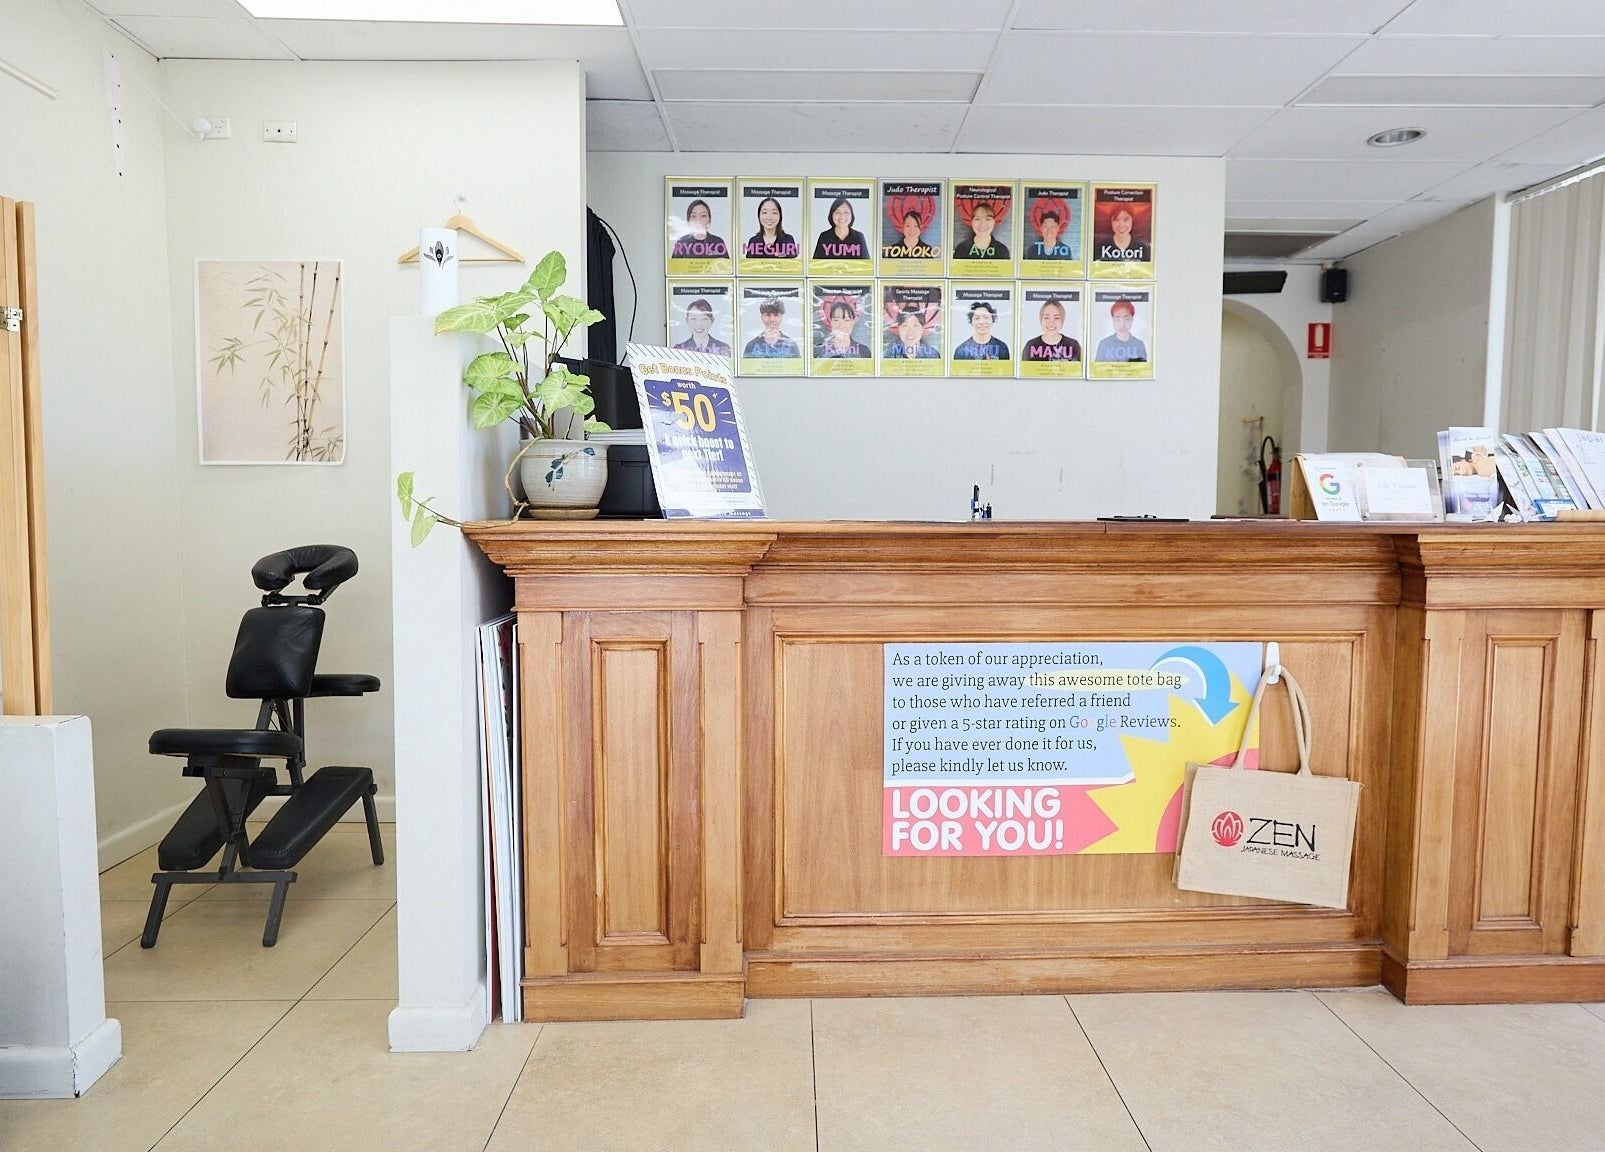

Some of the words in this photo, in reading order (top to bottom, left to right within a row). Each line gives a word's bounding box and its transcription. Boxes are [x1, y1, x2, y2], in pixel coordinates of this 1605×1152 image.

[674, 242, 726, 256] RYOKO
[743, 242, 801, 256] MEGURI
[822, 243, 861, 257] YUMI
[882, 245, 940, 258] TOMOKO
[969, 244, 996, 258] Aya
[1101, 245, 1143, 259] Kotori
[1030, 346, 1073, 358] MAYU
[639, 363, 658, 375] Get
[660, 363, 693, 376] Bonus
[694, 366, 728, 385] Points
[676, 381, 696, 389] worth
[661, 391, 717, 433] $50
[698, 436, 724, 449] boost
[724, 438, 735, 450] to
[892, 652, 910, 666] As
[913, 655, 922, 666] a
[926, 651, 964, 666] token
[968, 650, 983, 665] of
[985, 654, 1008, 665] our
[1012, 651, 1103, 668] appreciation,
[892, 677, 913, 687] we
[917, 676, 939, 687] are
[942, 674, 984, 691] giving
[988, 675, 1026, 690] away
[1029, 672, 1055, 686] this
[1058, 675, 1123, 686] awesome
[1127, 673, 1153, 686] tote
[1157, 672, 1182, 690] bag
[892, 696, 906, 709] to
[910, 694, 947, 709] those
[950, 694, 981, 708] who
[984, 693, 1018, 708] have
[1021, 693, 1075, 708] referred
[1079, 697, 1087, 707] a
[1090, 693, 1131, 707] friend
[892, 719, 906, 730] or
[909, 716, 947, 733] given
[951, 719, 959, 730] a
[962, 717, 1002, 731] 5-star
[1005, 716, 1046, 733] rating
[1049, 718, 1066, 729] on
[1069, 714, 1117, 732] Gogle
[1120, 715, 1181, 728] Reviews.
[892, 737, 904, 751] If
[905, 740, 931, 755] you
[935, 736, 968, 751] have
[972, 740, 1002, 751] ever
[1005, 736, 1039, 751] done
[1042, 737, 1052, 750] it
[1055, 736, 1074, 750] for
[1077, 739, 1097, 752] us,
[892, 758, 936, 776] please
[940, 757, 984, 776] kindly
[987, 757, 1005, 772] let
[1008, 760, 1024, 772] us
[1027, 757, 1067, 772] know.
[892, 787, 1061, 819] LOOKING
[892, 820, 963, 851] FOR
[974, 819, 1064, 850] YOU!
[1246, 817, 1316, 852] ZEN
[1241, 845, 1279, 856] JAPANESE
[1281, 850, 1321, 862] MASSAGE
